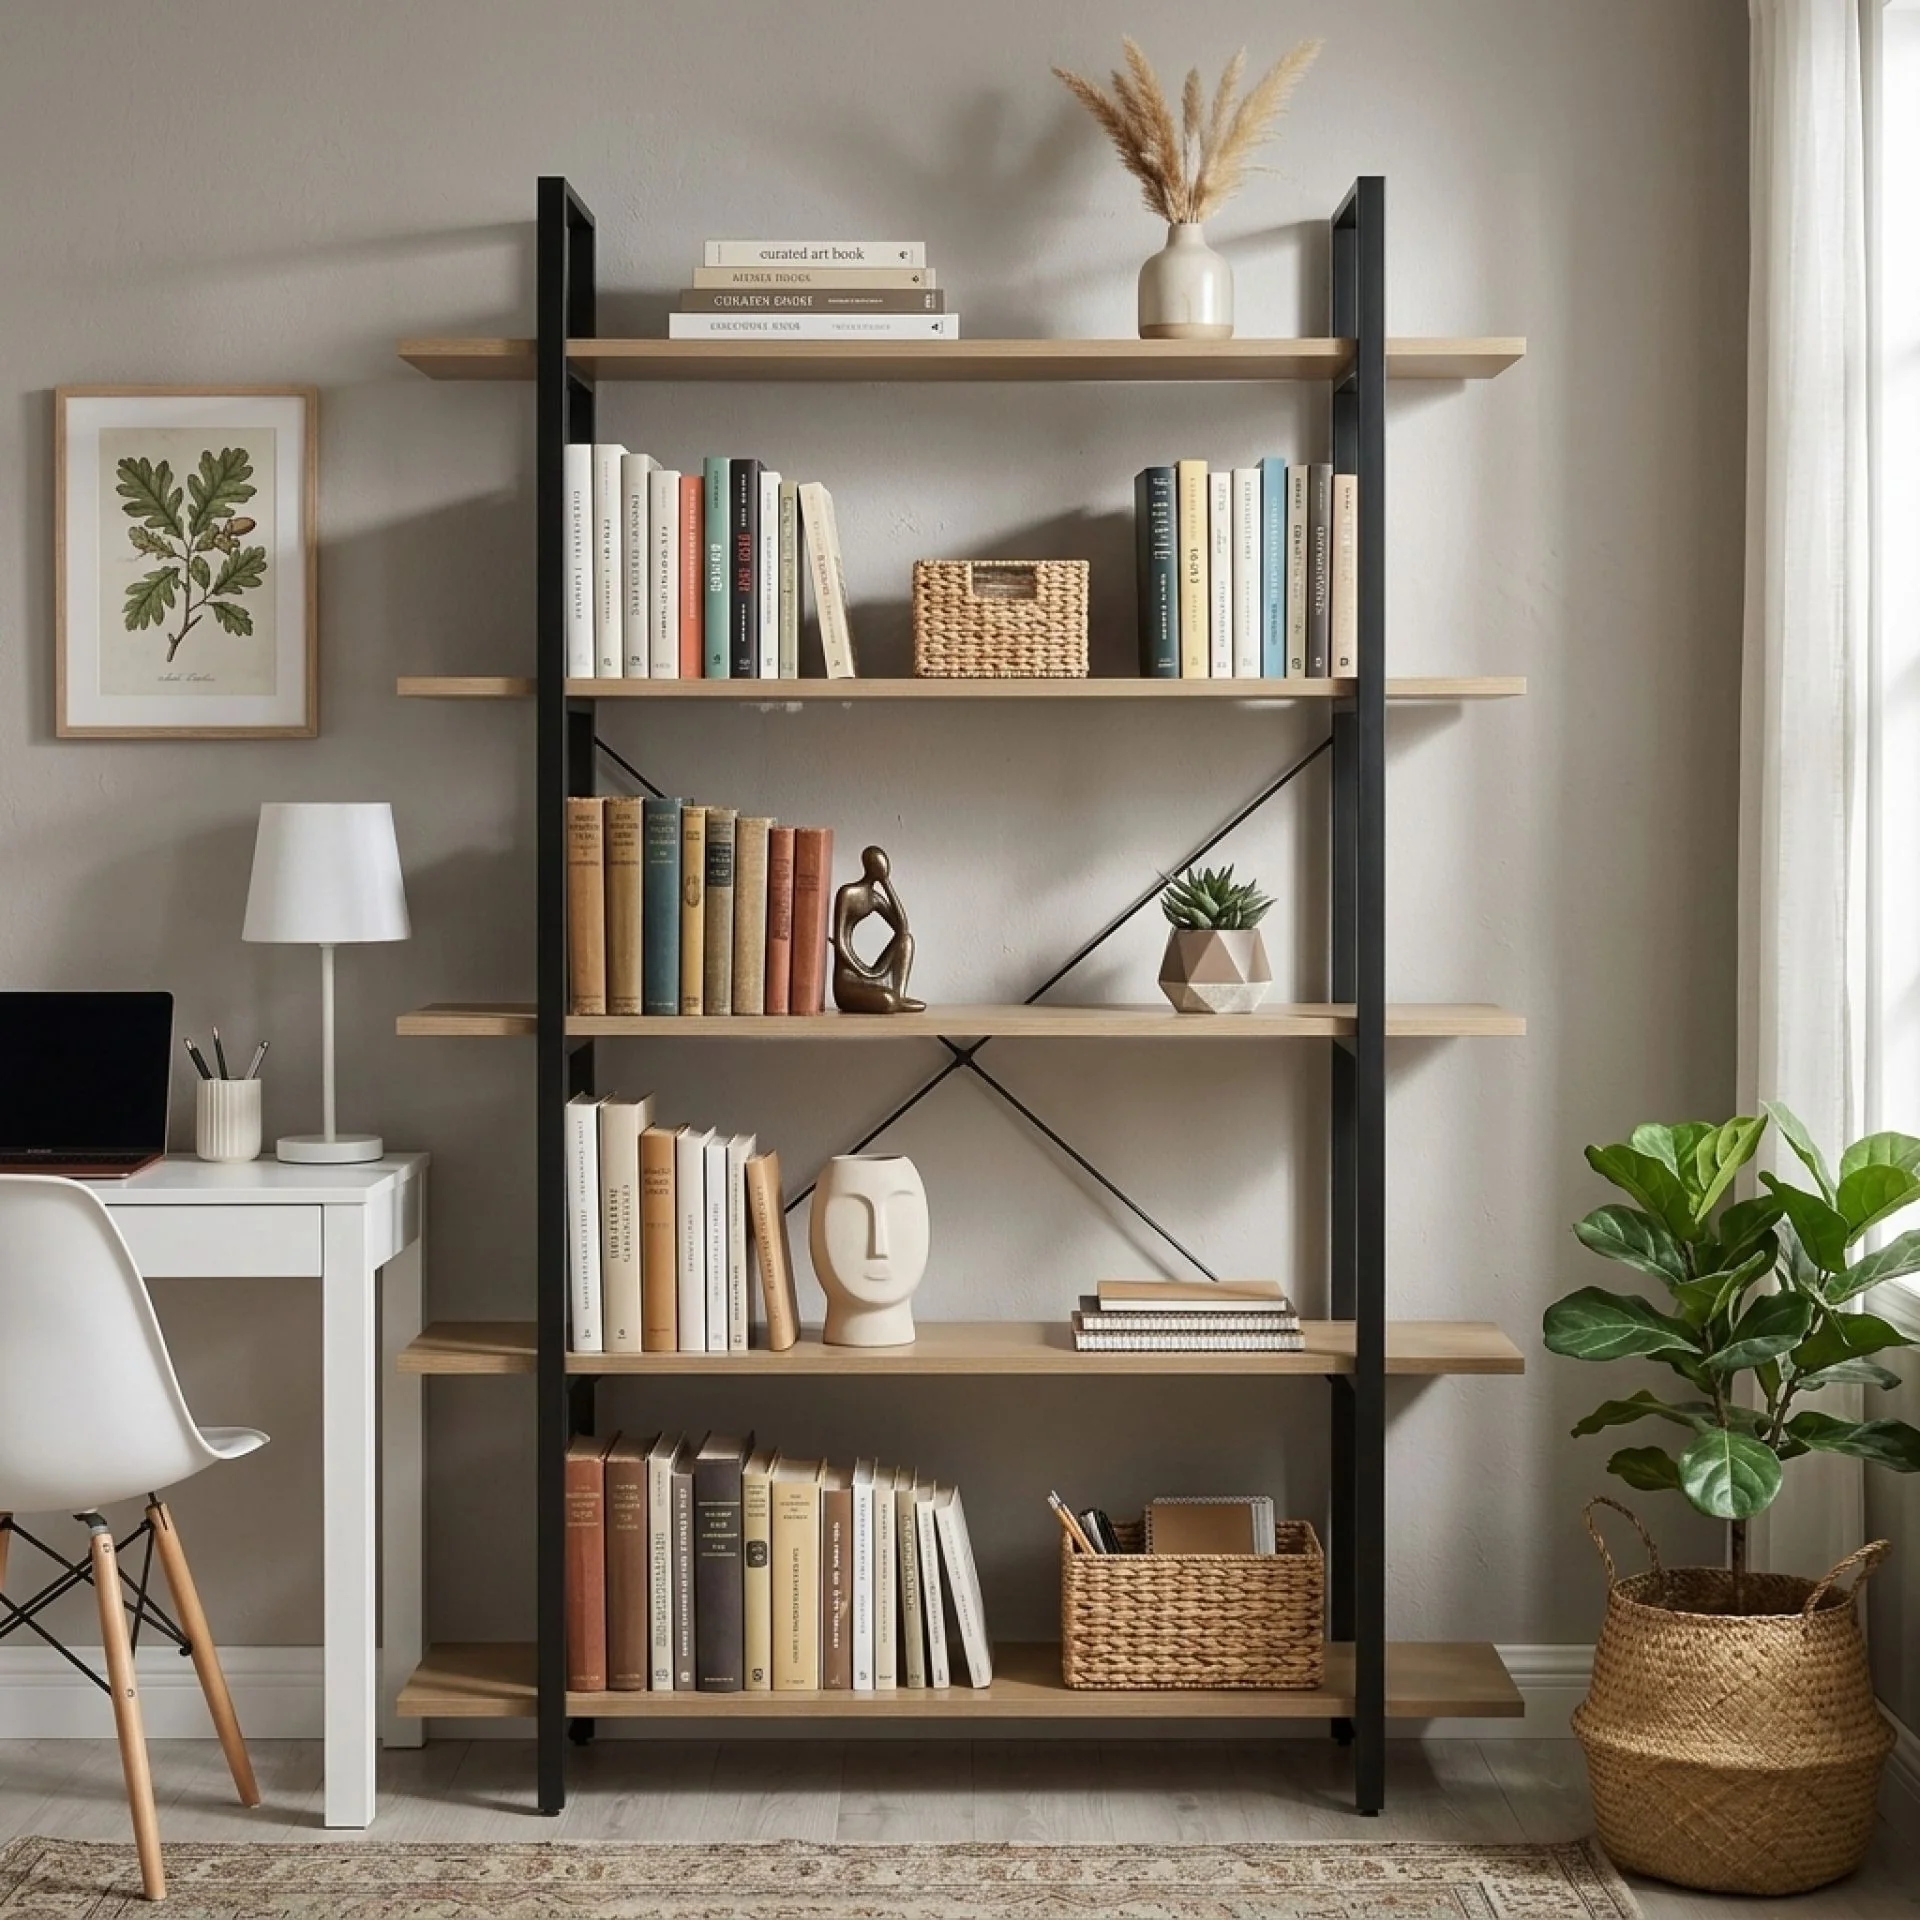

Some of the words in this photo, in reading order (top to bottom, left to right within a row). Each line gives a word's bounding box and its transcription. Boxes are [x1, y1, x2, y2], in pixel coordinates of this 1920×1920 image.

[759, 247, 808, 260] curated
[811, 249, 829, 260] art
[832, 247, 865, 260] book
